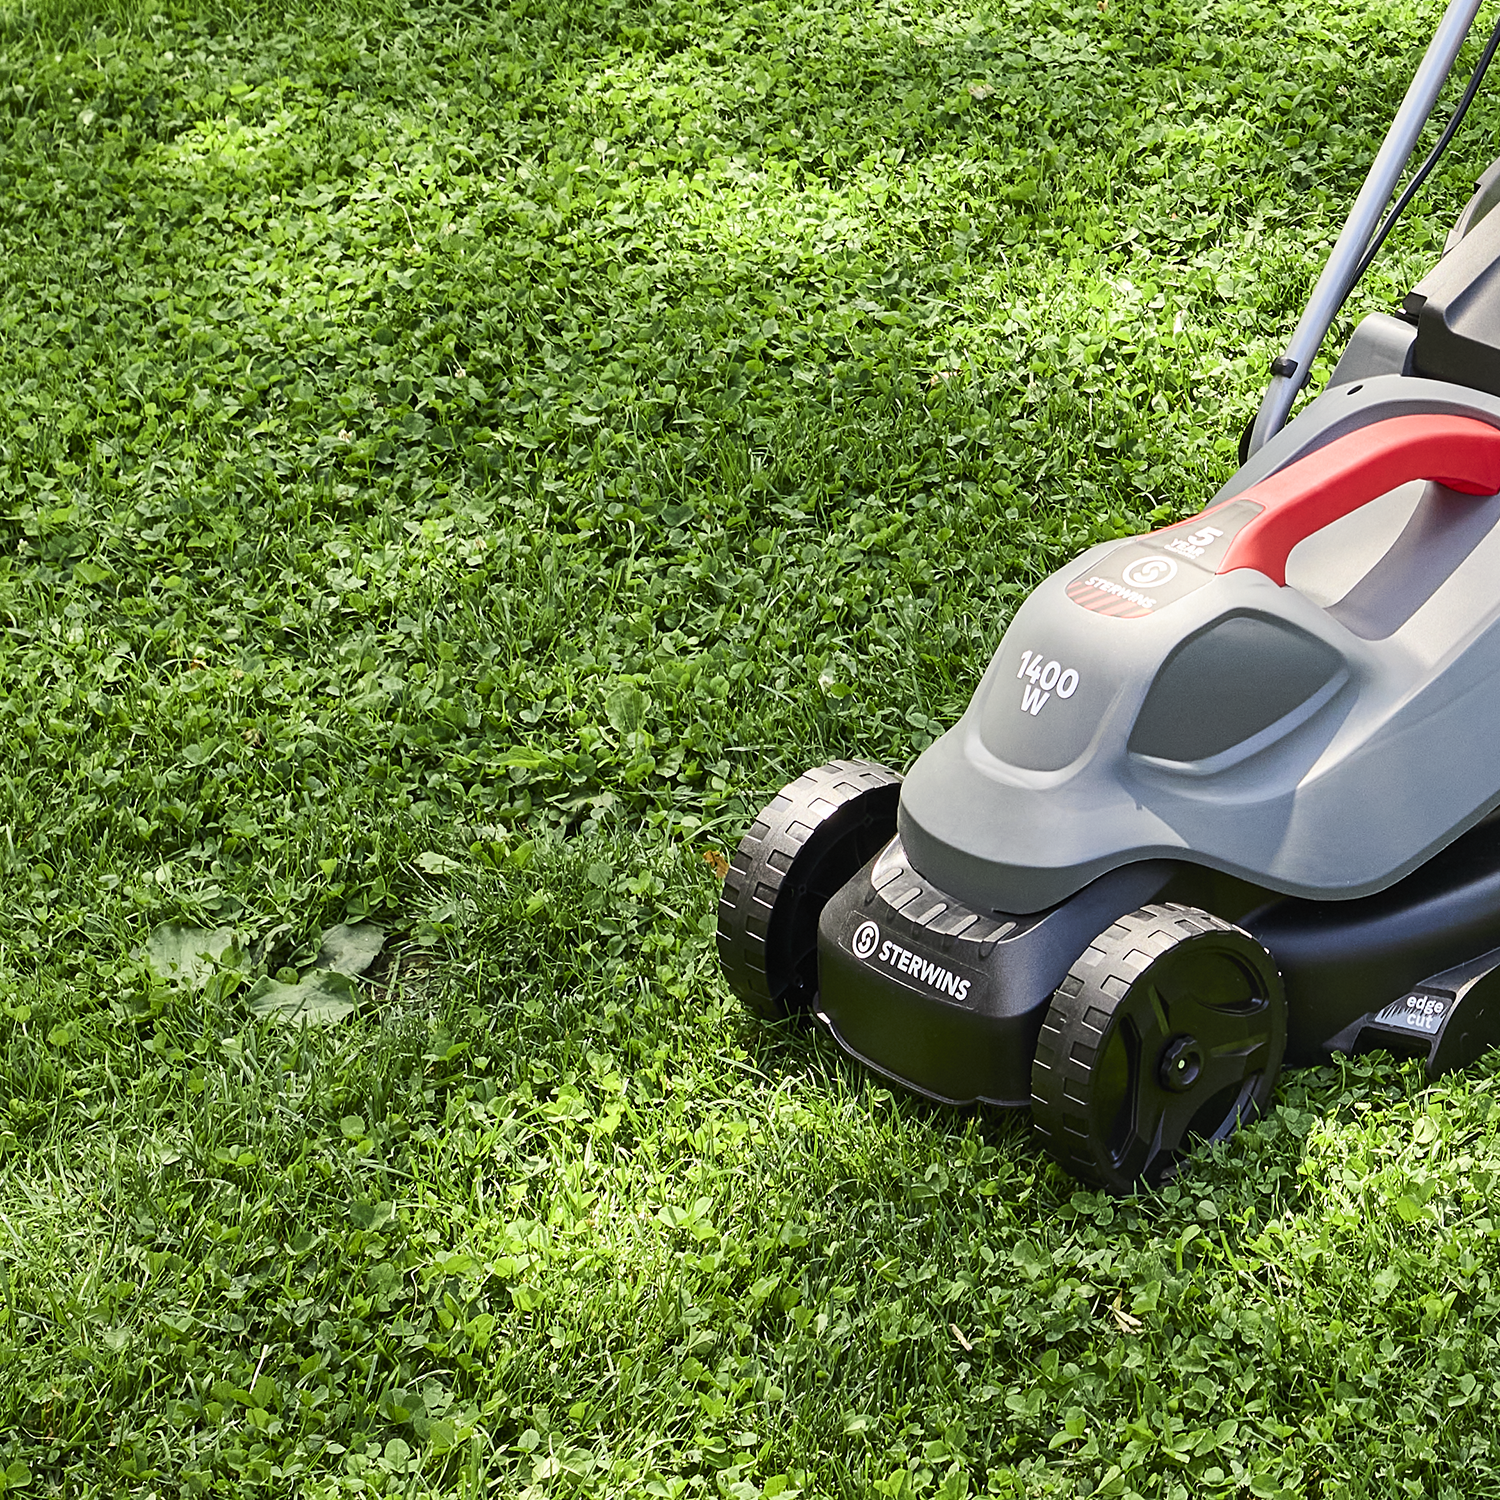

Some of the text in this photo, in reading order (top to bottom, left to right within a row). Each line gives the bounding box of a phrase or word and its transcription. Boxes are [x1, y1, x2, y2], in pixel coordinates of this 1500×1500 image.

[1169, 537, 1206, 558] YEAR
[1187, 526, 1224, 546] 5
[1085, 576, 1157, 609] STERWINS
[1016, 650, 1080, 699] 1400
[1020, 684, 1051, 717] W
[878, 940, 972, 1001] STERWINS
[1406, 995, 1444, 1015] edge
[1406, 1013, 1433, 1029] cut
